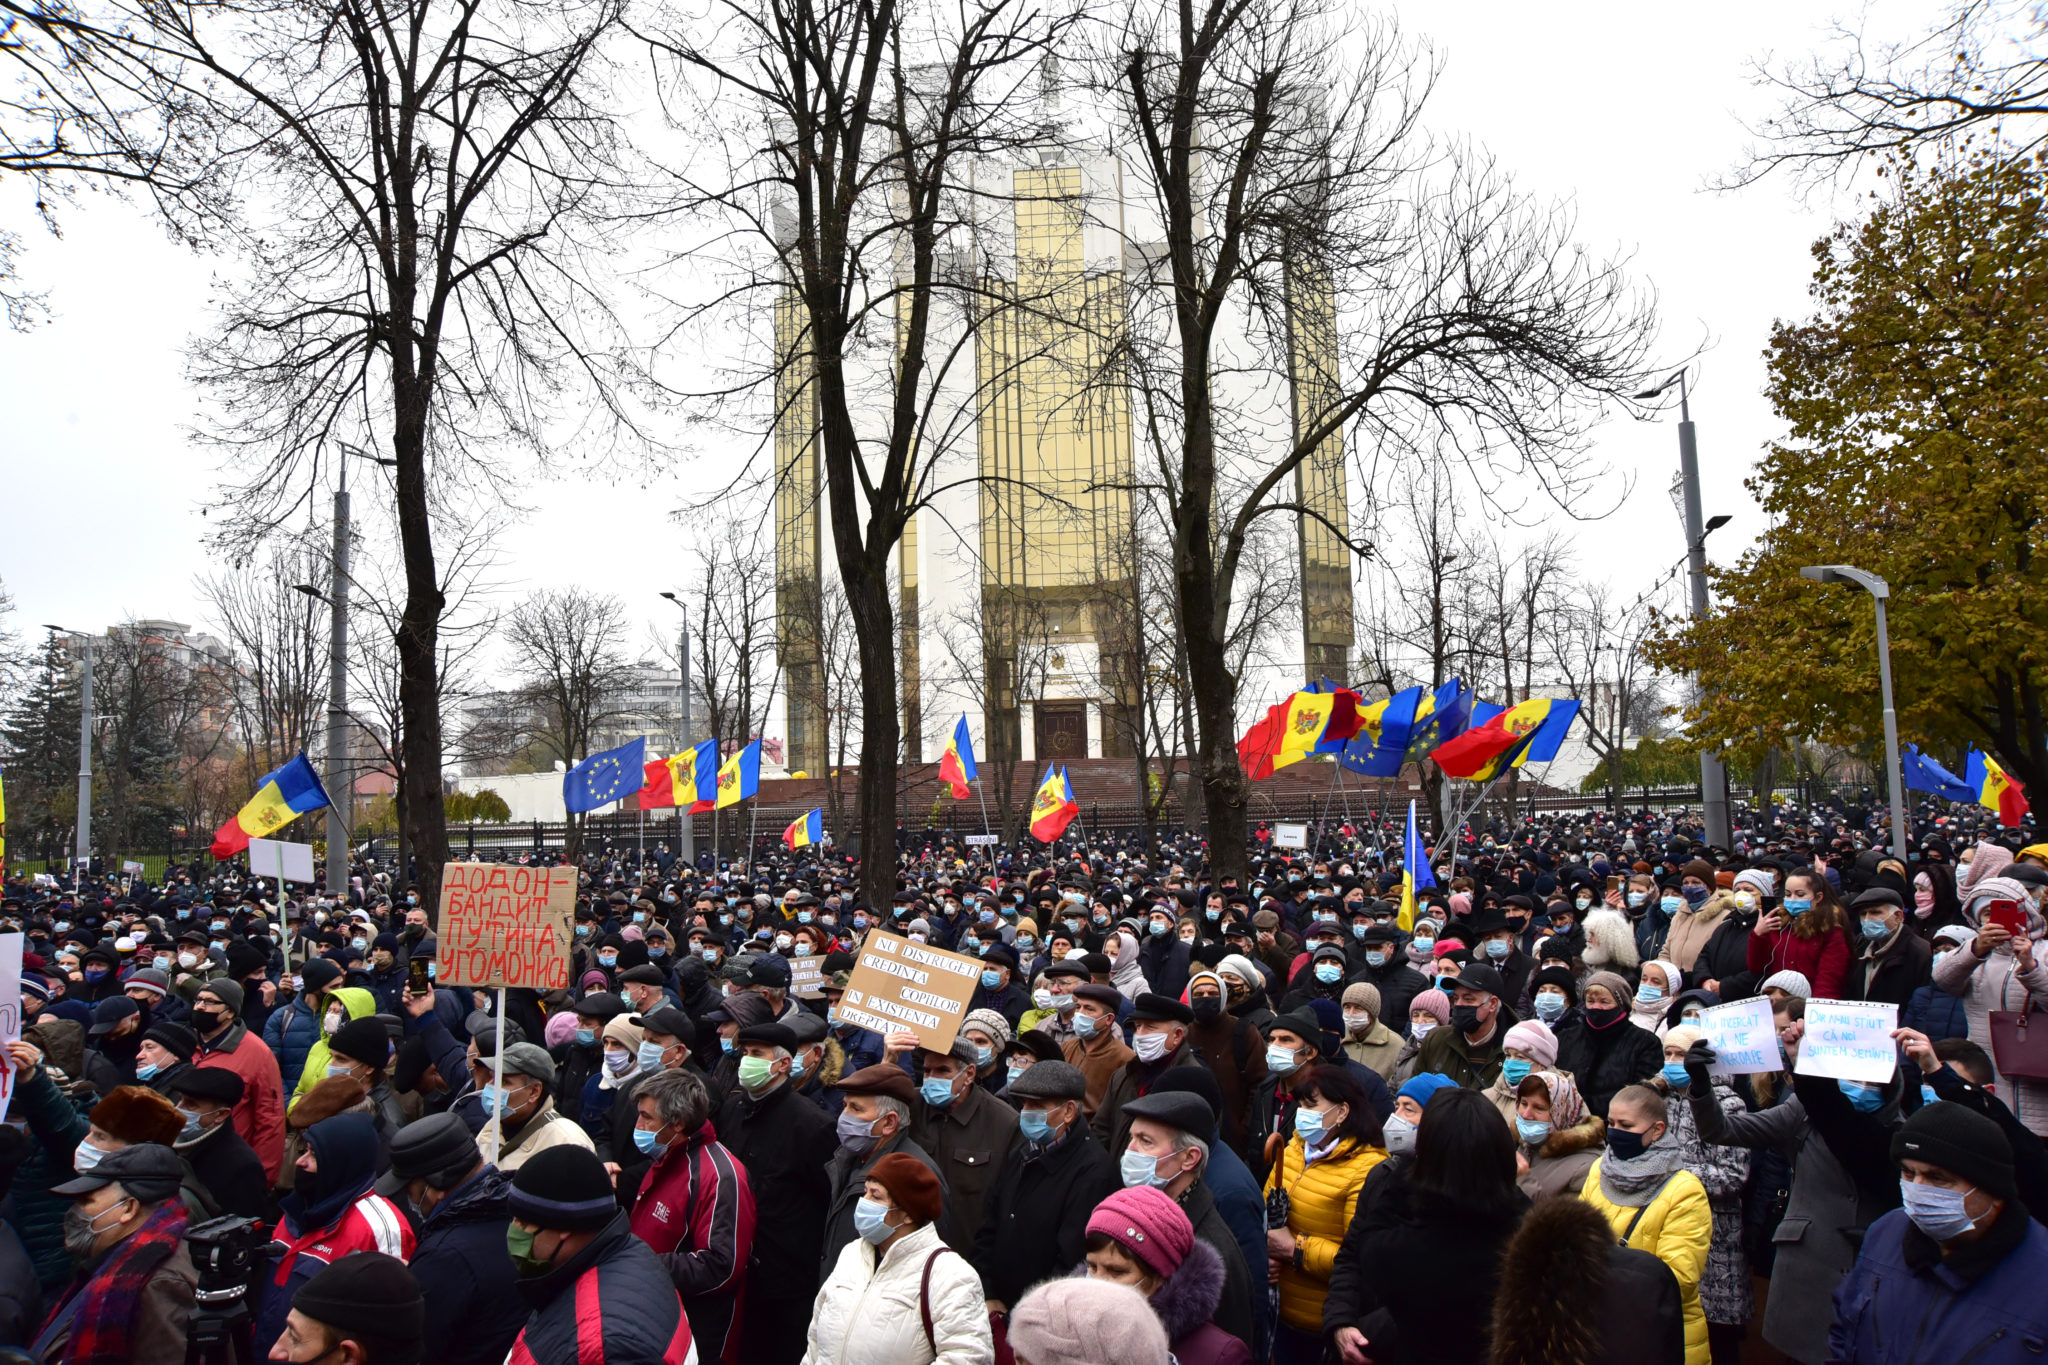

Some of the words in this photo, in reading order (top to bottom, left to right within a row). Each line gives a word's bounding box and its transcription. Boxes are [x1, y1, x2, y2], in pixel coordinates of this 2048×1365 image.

[448, 891, 549, 924] БАНДИТ
[446, 917, 556, 956] ПУТИНА
[439, 946, 569, 988] УГОМОНИСЬ
[862, 955, 927, 984] CREDINTA
[878, 938, 898, 953] NU
[902, 945, 980, 978] DISTRUGETI
[867, 996, 938, 1029] EXISTENTA
[901, 987, 960, 1014] COPIILOR
[1734, 1032, 1749, 1047] NE
